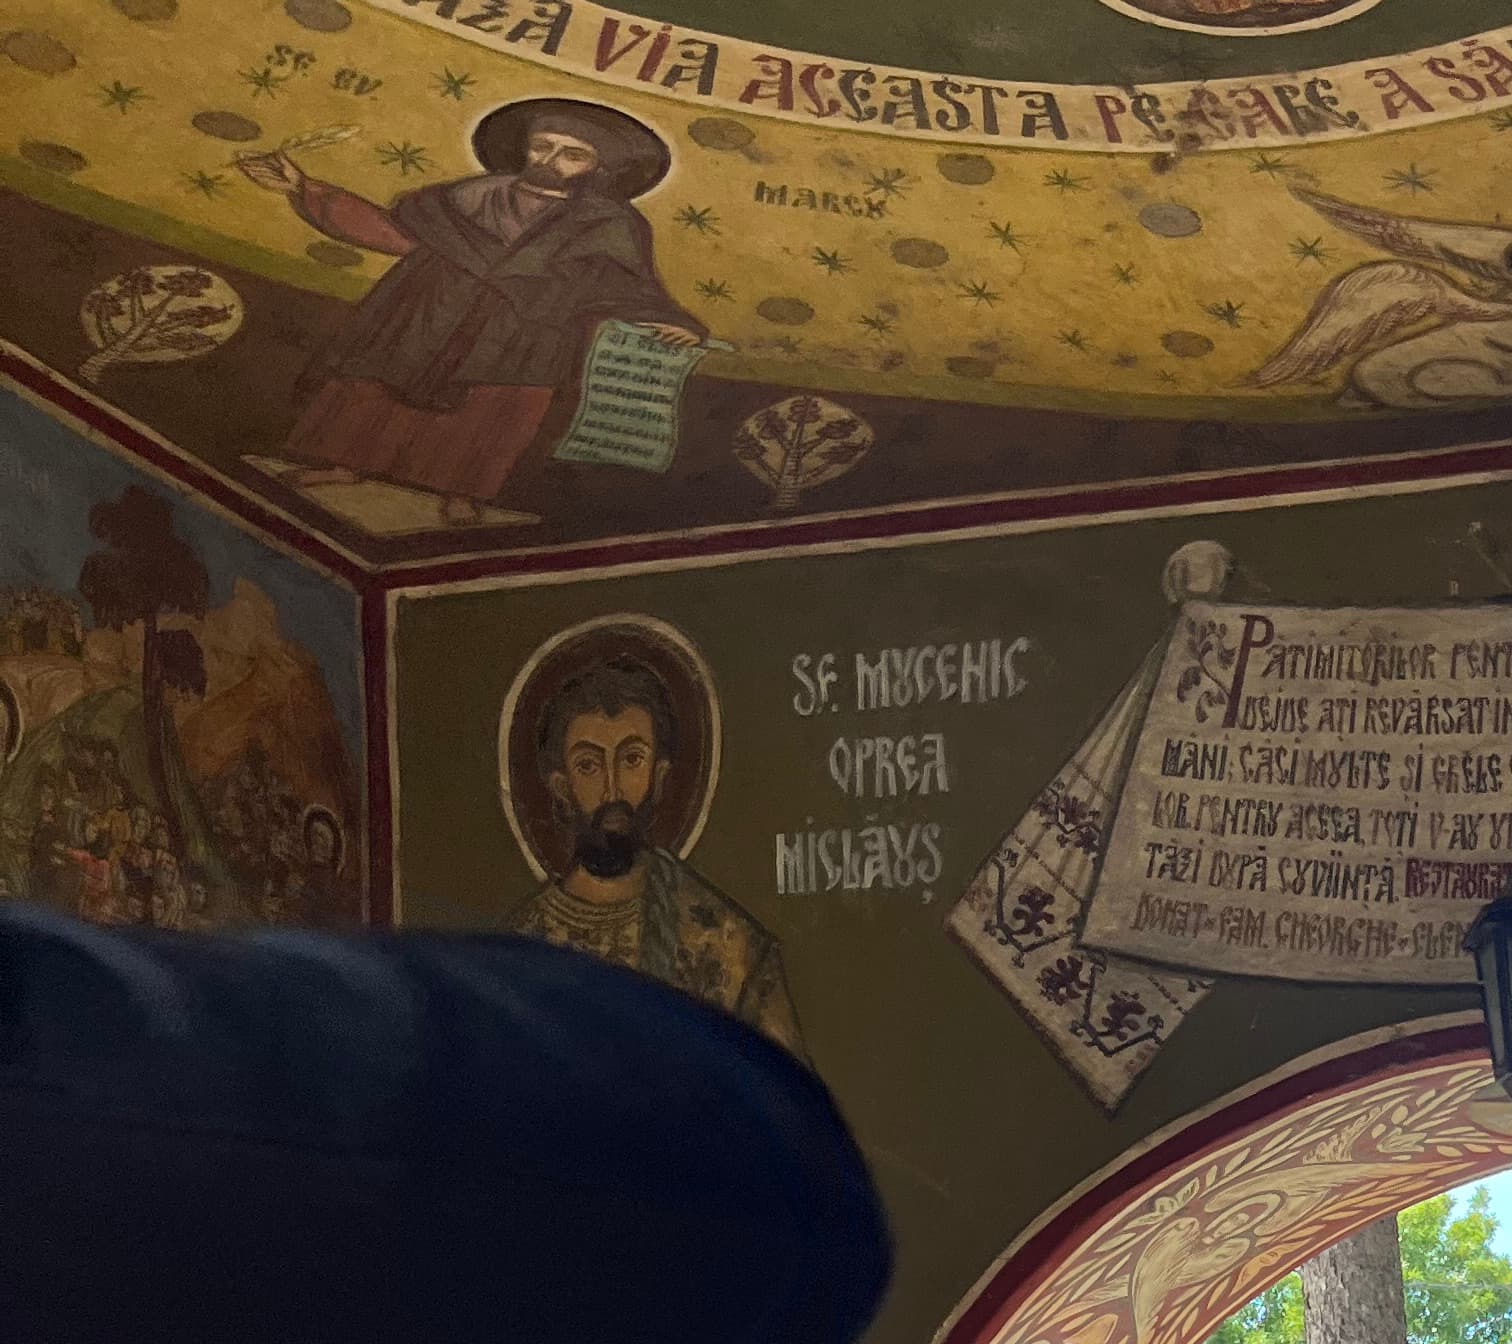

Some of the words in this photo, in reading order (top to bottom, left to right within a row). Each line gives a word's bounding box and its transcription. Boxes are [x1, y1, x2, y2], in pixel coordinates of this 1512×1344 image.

[594, 16, 720, 97] VIA
[739, 51, 1069, 142] ACEASTA
[1095, 91, 1174, 144] PE
[1364, 67, 1435, 121] A
[829, 732, 951, 800] OPREA
